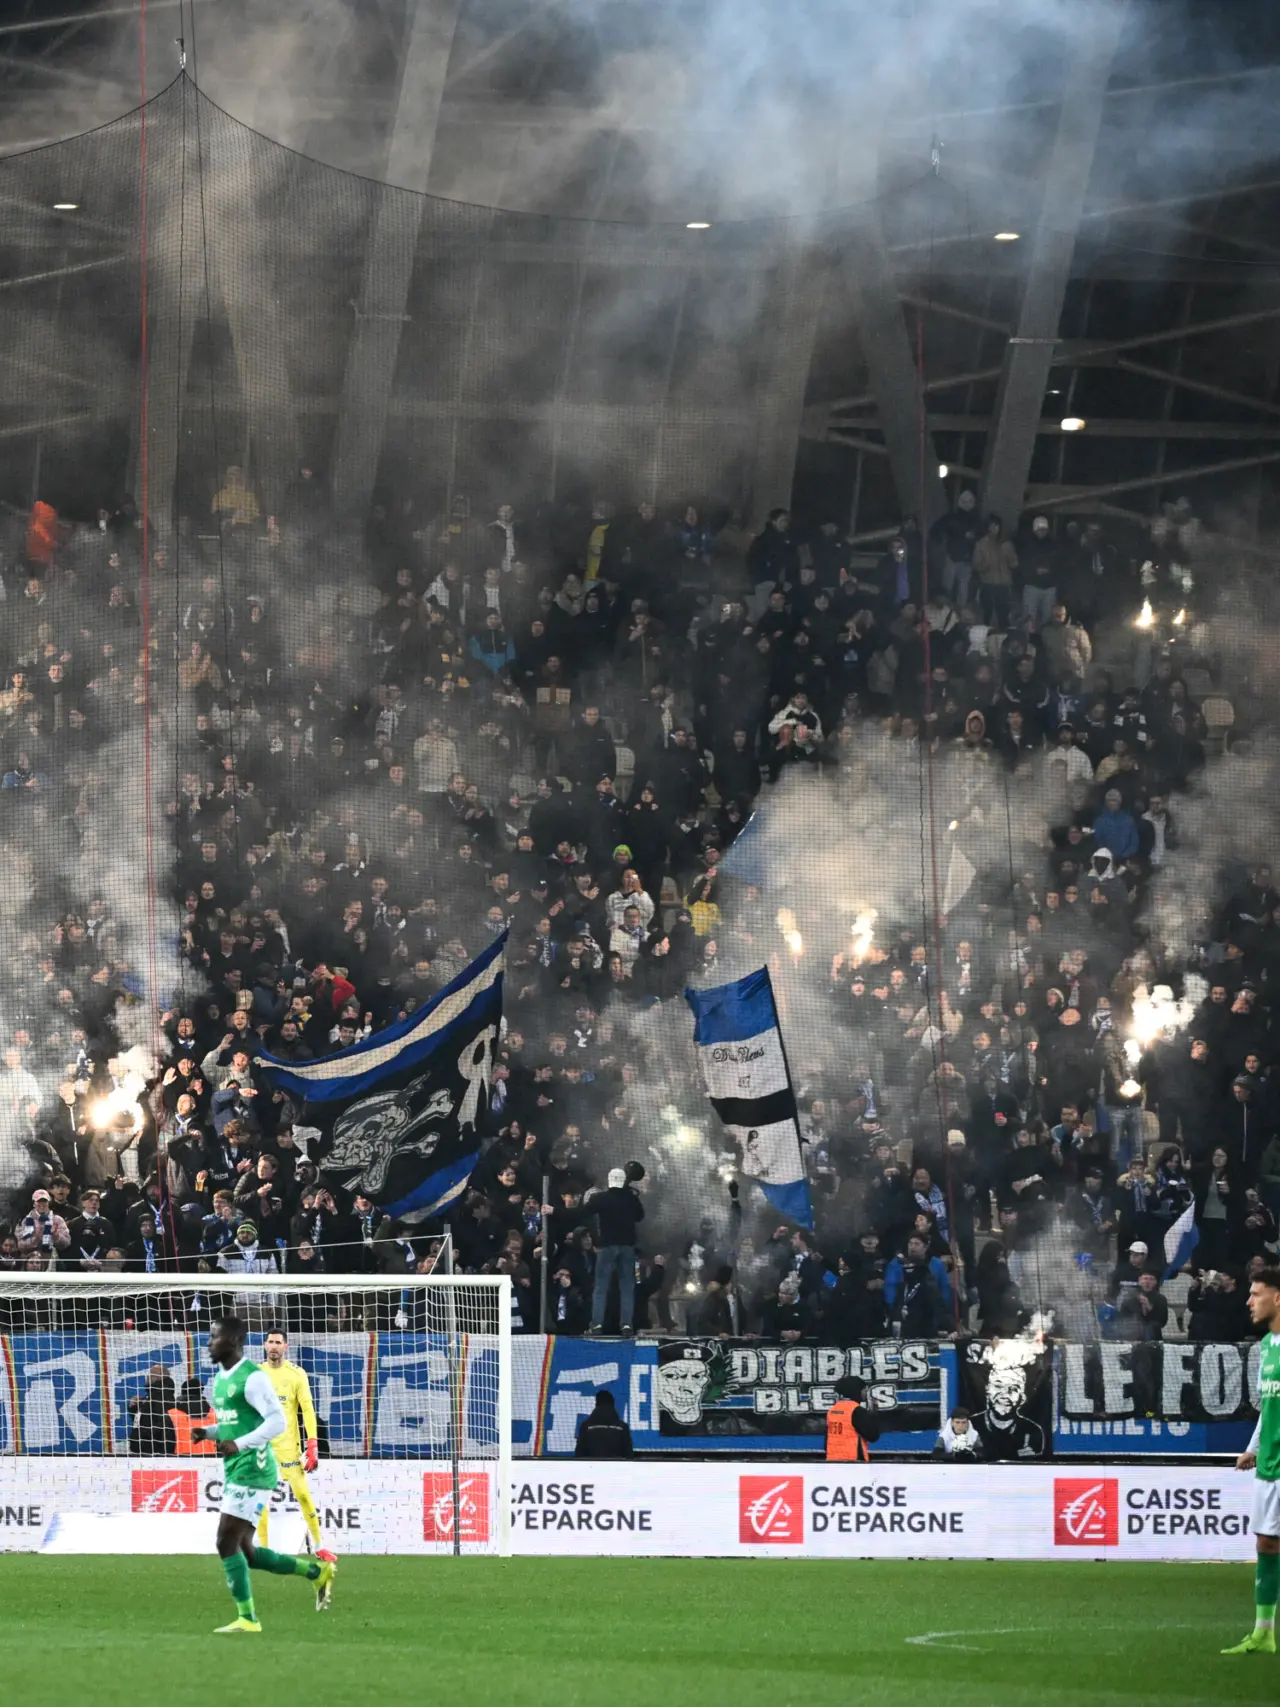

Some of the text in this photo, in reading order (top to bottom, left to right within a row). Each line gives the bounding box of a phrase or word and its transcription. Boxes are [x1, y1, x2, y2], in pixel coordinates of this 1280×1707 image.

[729, 1344, 929, 1384] DIABLES
[1064, 1343, 1135, 1414] LE
[753, 1384, 898, 1414] BLES
[511, 1484, 595, 1505] AISSE
[811, 1486, 907, 1507] CAISSE
[1126, 1488, 1221, 1510] CAISSE
[812, 1511, 964, 1533] D'EPARGNE
[1128, 1514, 1250, 1536] D'EPARG
